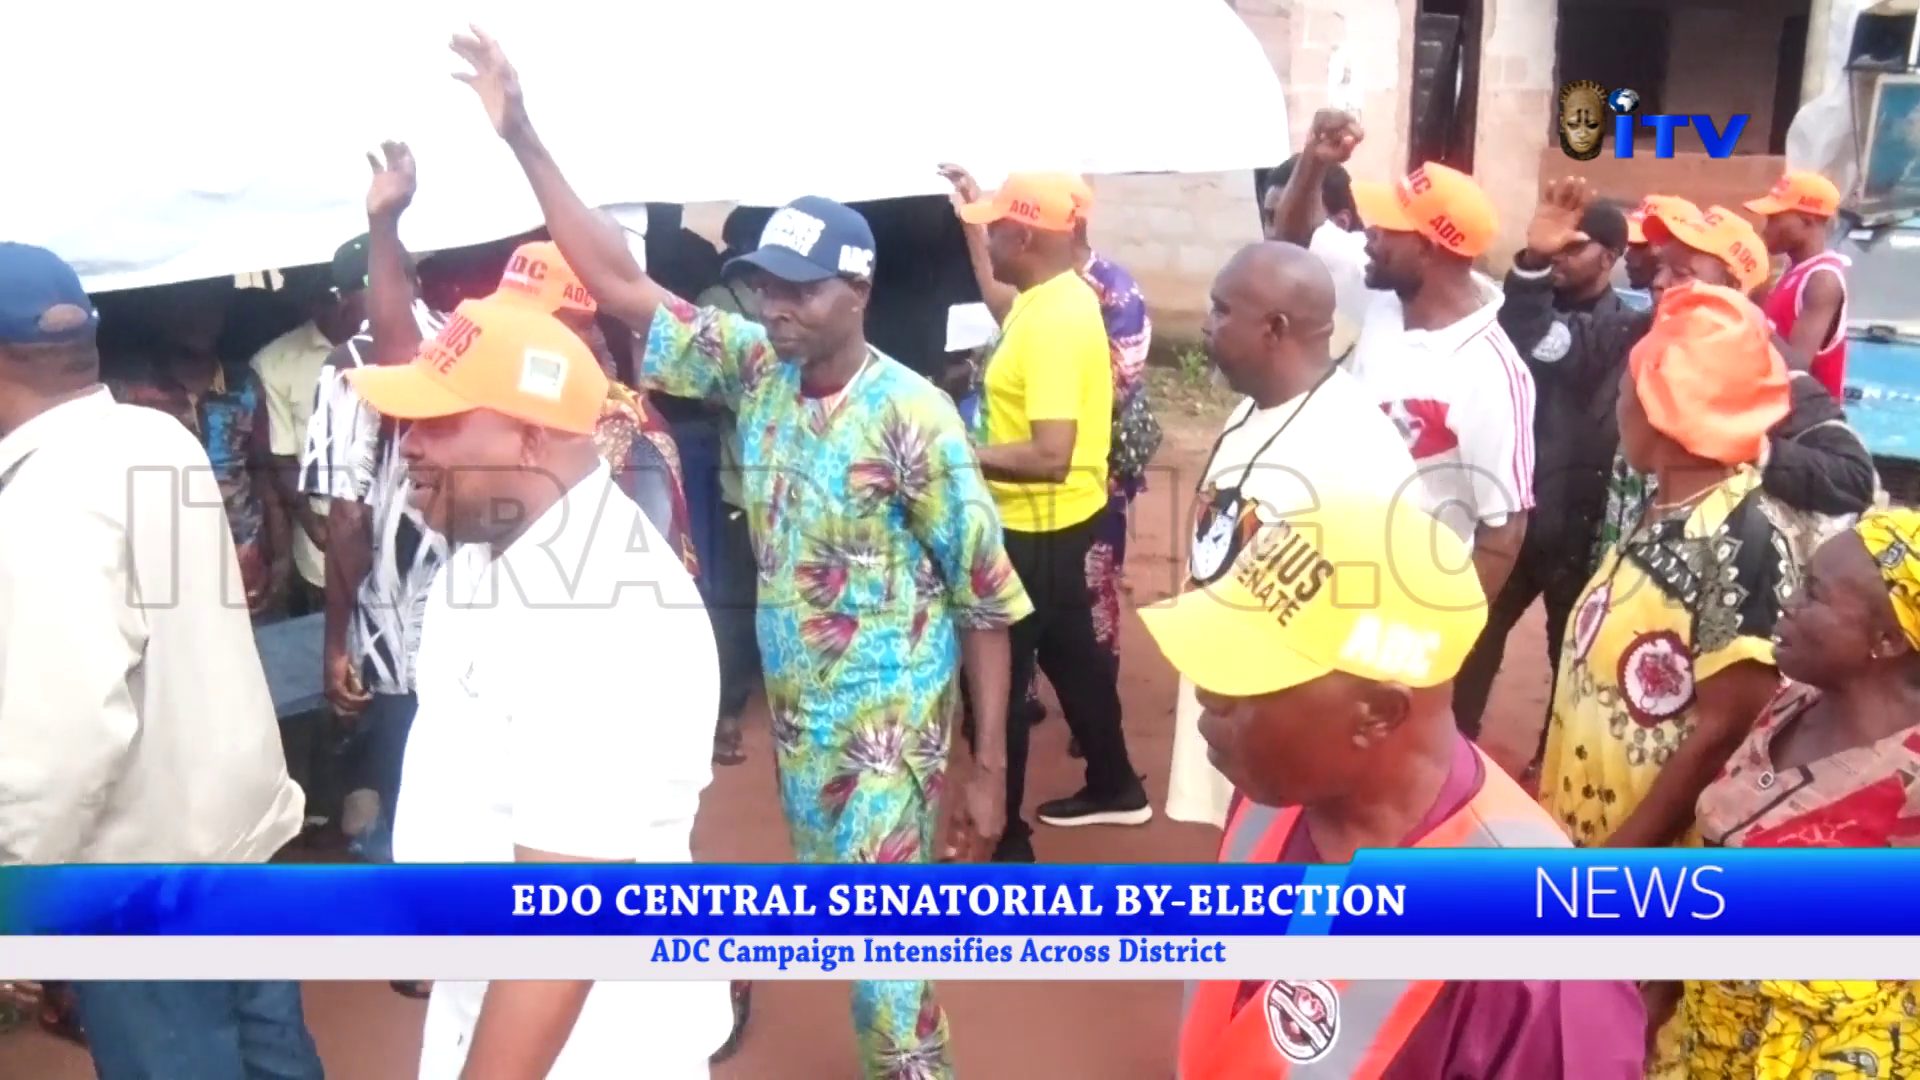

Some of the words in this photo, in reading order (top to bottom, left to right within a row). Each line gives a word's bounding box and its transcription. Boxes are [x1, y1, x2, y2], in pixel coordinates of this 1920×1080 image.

[1008, 200, 1041, 220] ADC
[1429, 215, 1465, 247] ADC
[509, 255, 548, 281] DC
